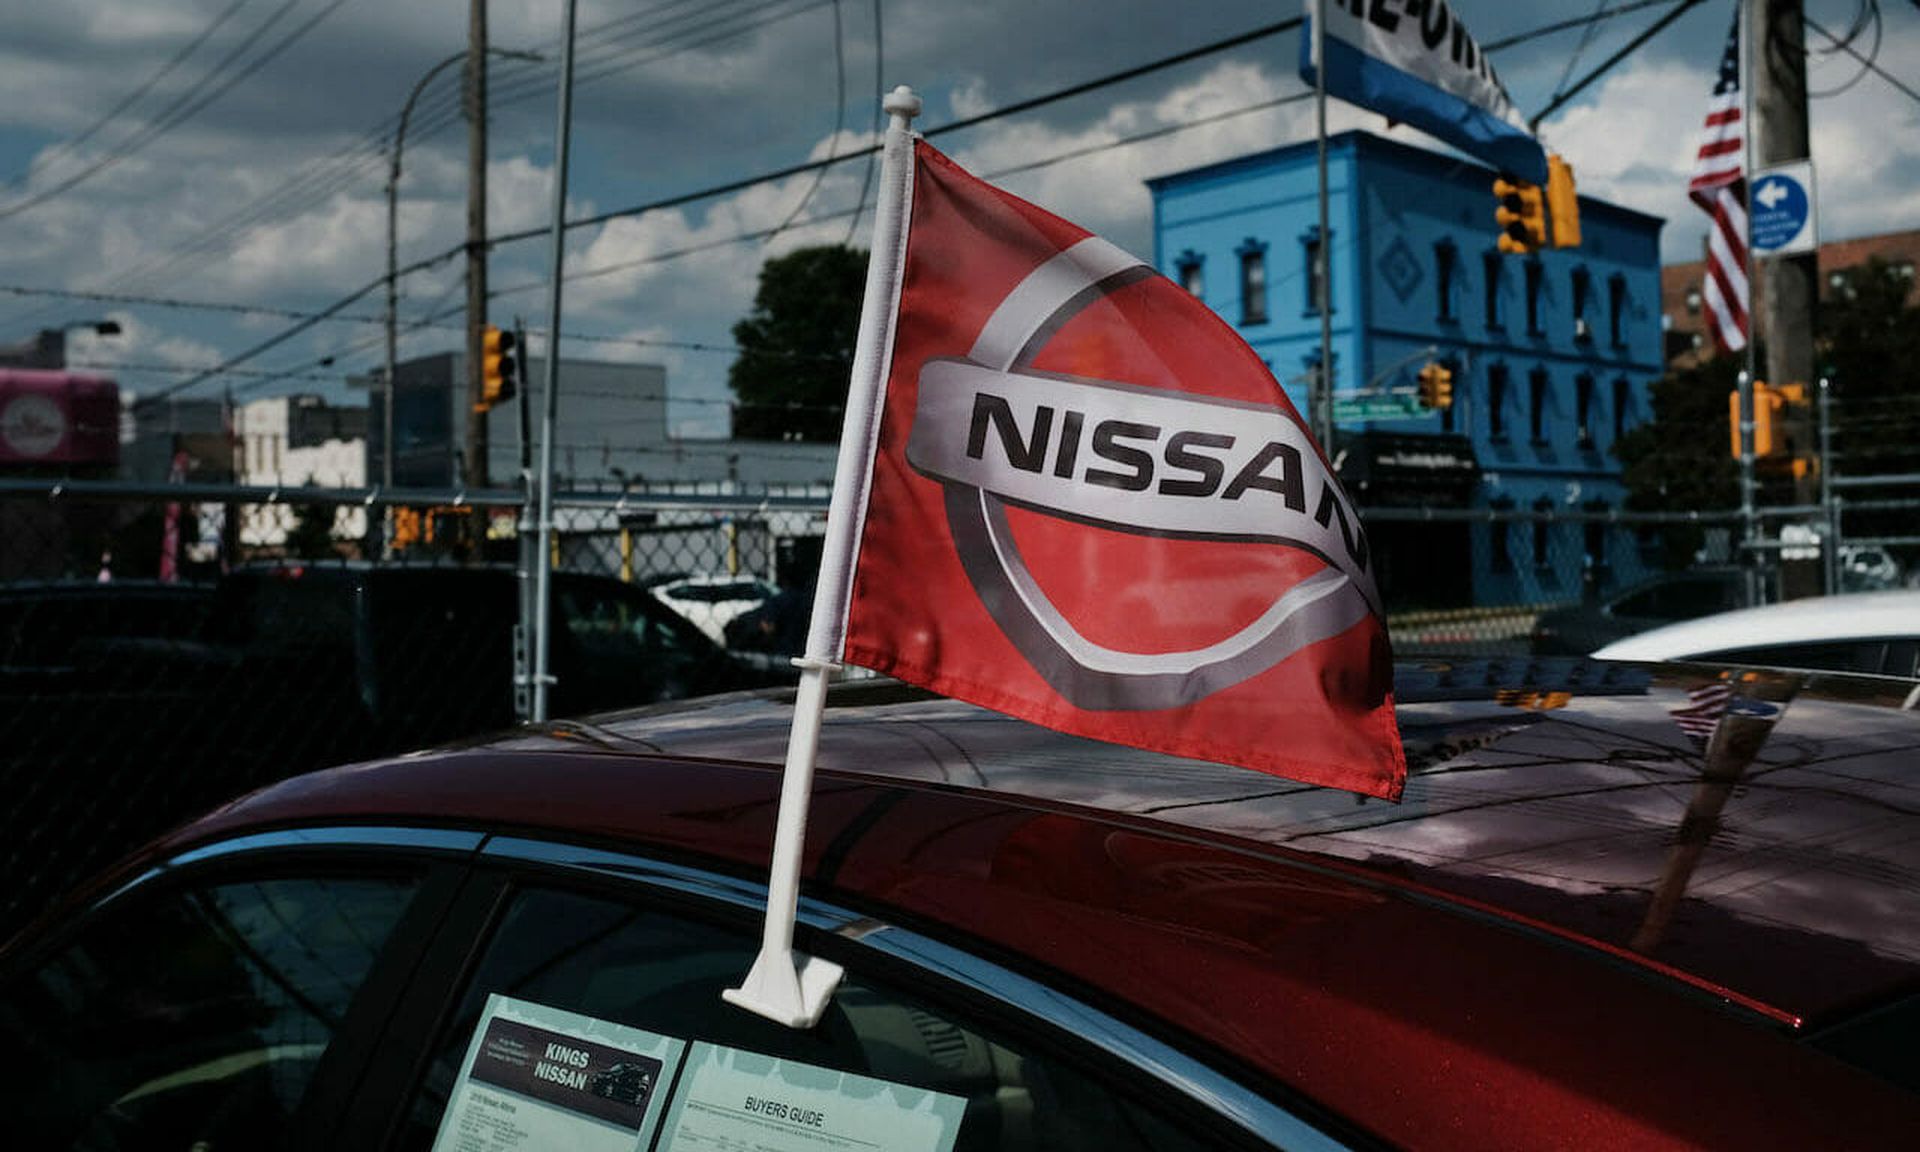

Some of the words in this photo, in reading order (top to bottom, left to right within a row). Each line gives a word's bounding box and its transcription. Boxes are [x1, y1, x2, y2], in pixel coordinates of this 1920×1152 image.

[966, 392, 1368, 575] NISSAN
[544, 1042, 590, 1069] KINGS
[534, 1061, 588, 1090] NISSAN
[744, 1096, 788, 1119] BUYERS
[789, 1106, 824, 1127] GUIDE
